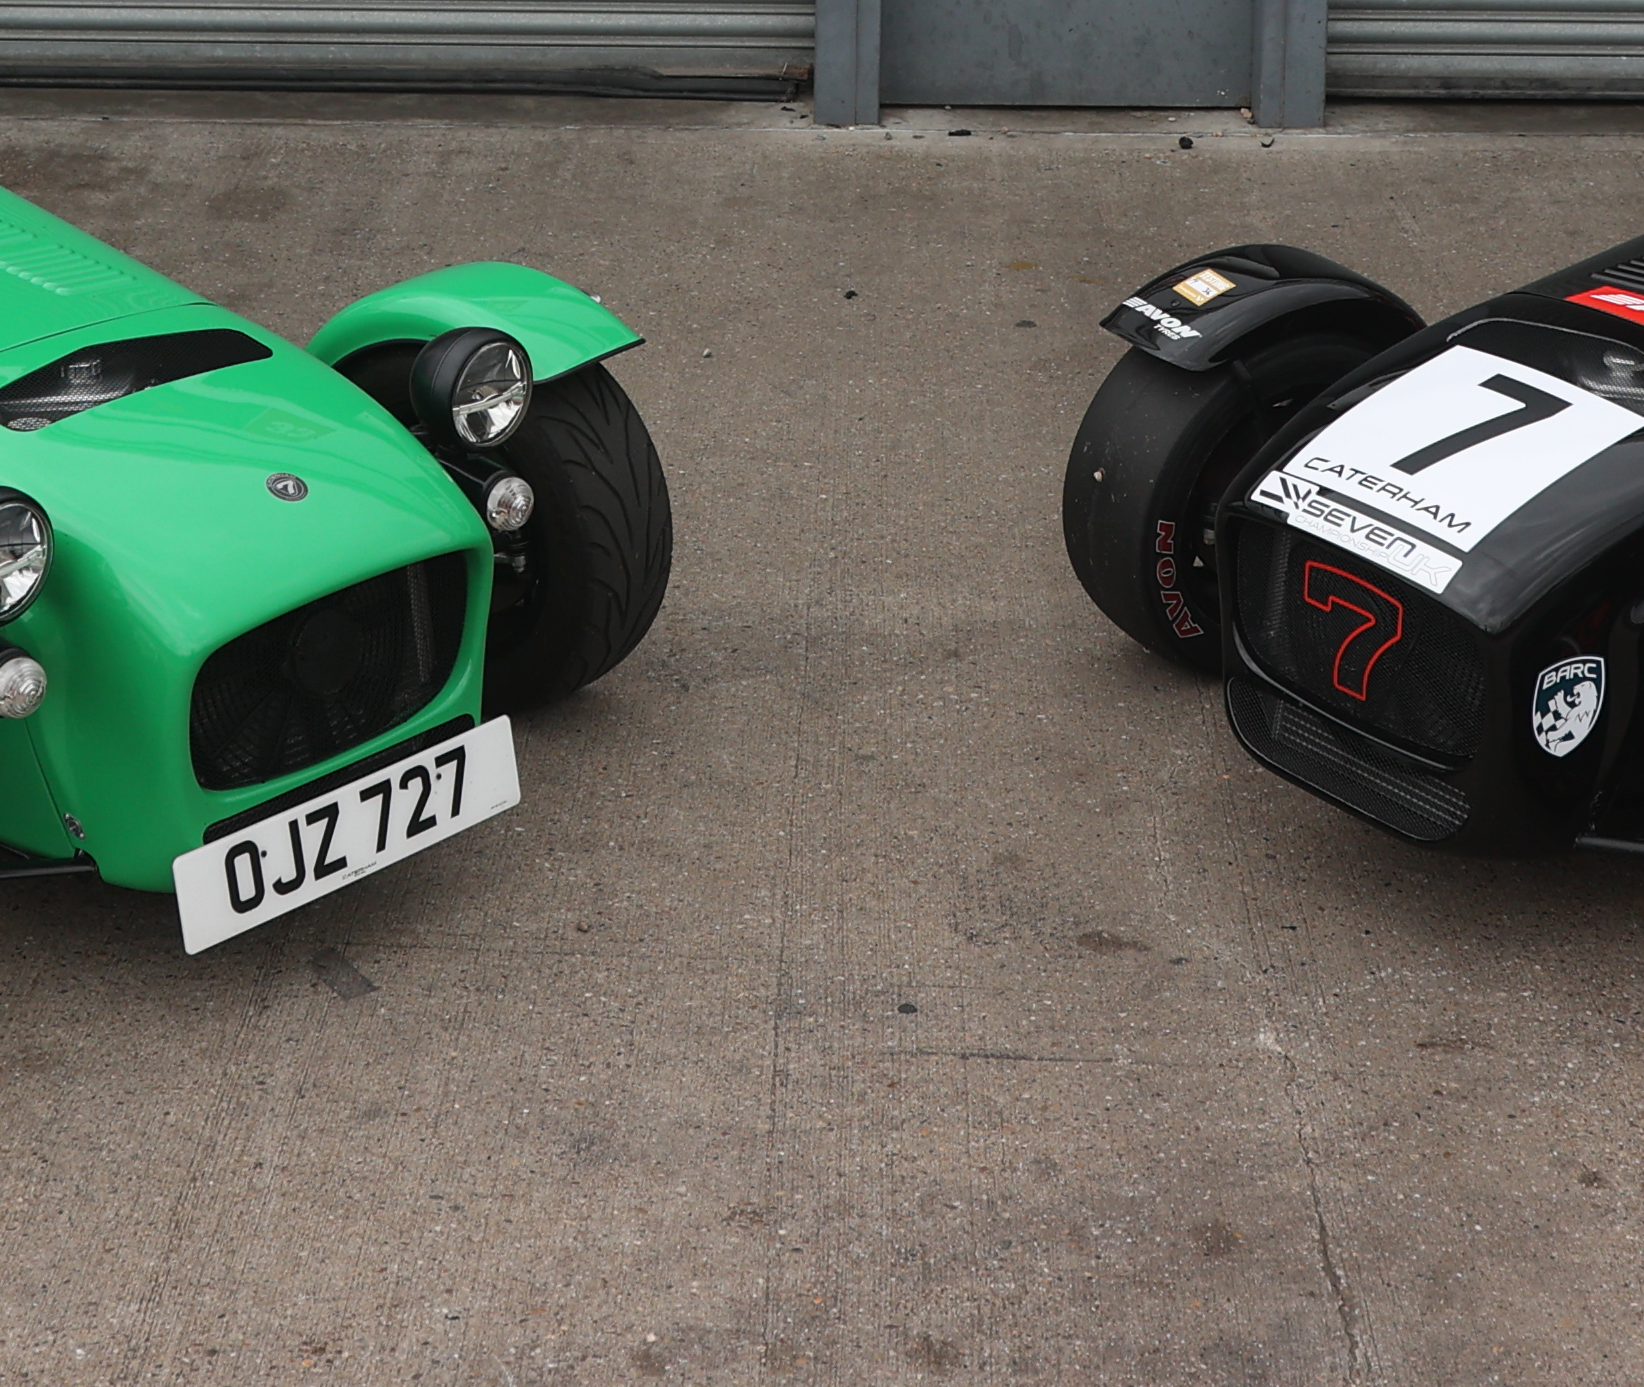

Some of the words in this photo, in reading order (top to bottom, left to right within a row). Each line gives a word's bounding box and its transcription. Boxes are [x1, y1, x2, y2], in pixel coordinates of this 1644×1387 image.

[1135, 304, 1202, 338] AVON
[1154, 323, 1181, 340] TYRES
[1389, 373, 1573, 476] 7
[1302, 499, 1417, 557] SEVEN
[1303, 457, 1472, 534] CATERHAM
[1156, 519, 1204, 638] AVON
[1294, 514, 1389, 562] CHAMPIONSHIP
[1387, 543, 1452, 588] UK
[1303, 560, 1403, 701] 7
[1542, 663, 1597, 690] BARC
[225, 801, 348, 914] OJZ
[359, 744, 466, 854] 727
